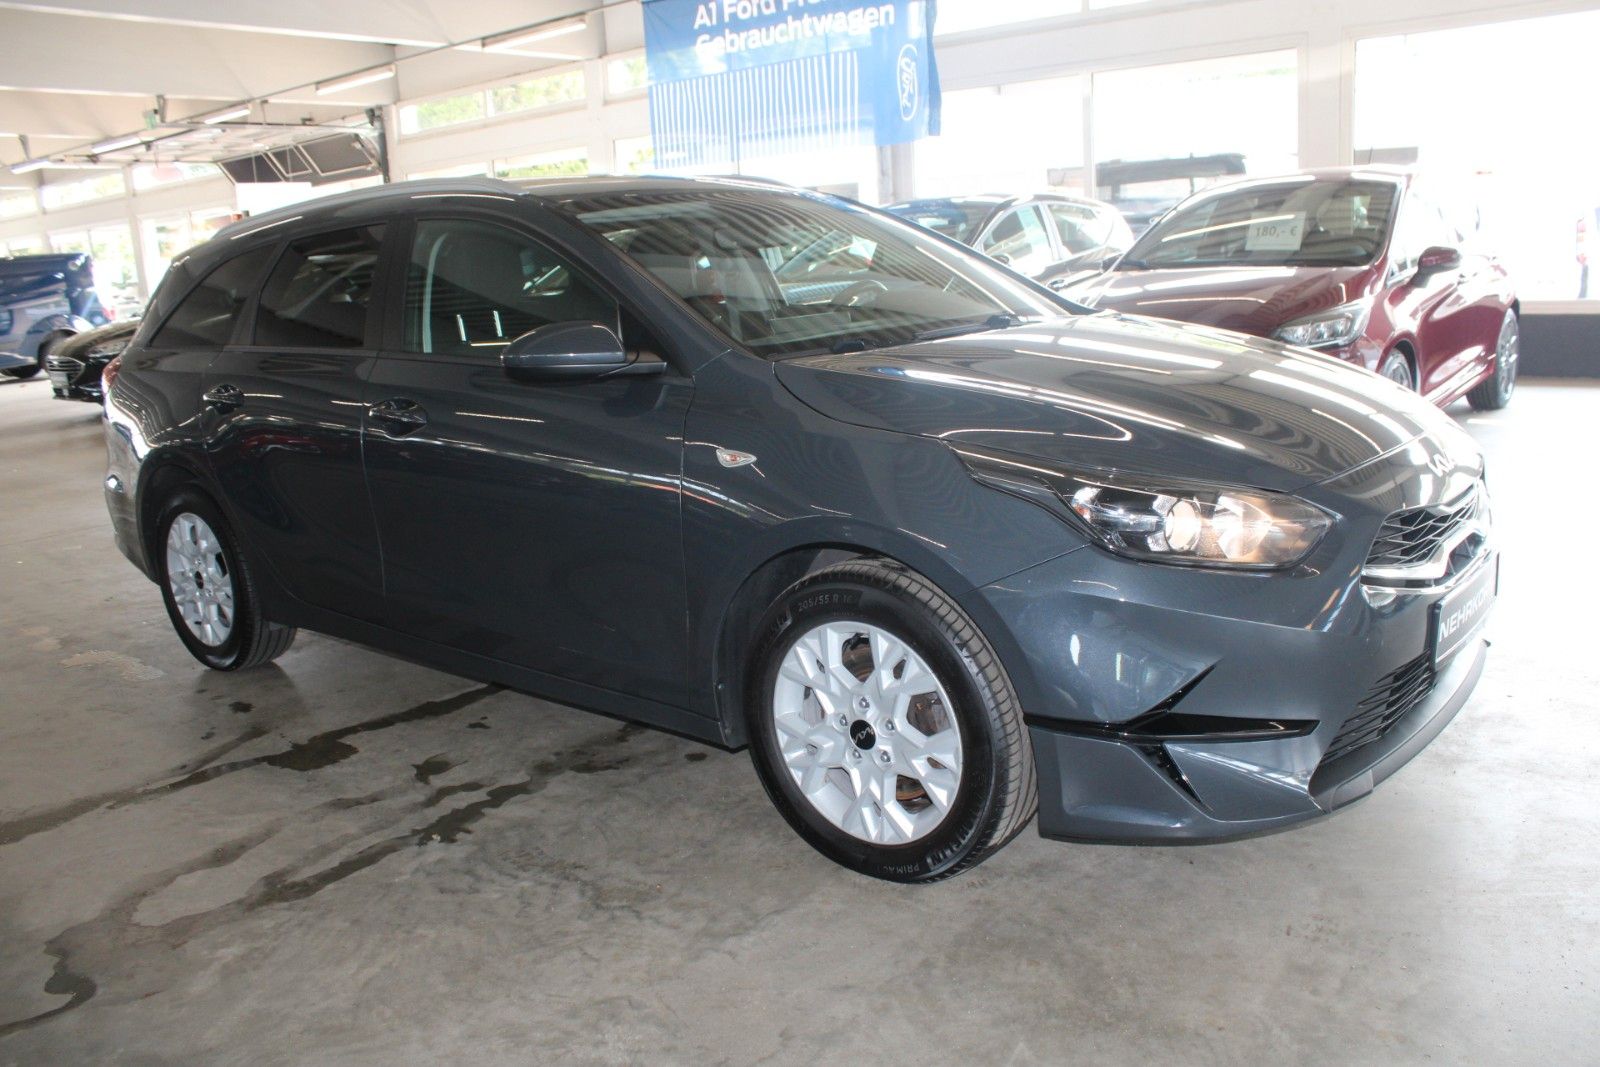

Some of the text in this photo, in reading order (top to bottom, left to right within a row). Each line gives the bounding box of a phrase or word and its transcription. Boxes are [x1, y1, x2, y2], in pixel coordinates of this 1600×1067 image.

[693, 1, 717, 29] A1
[723, 0, 776, 23] Ford
[694, 3, 895, 53] Gebrauchtwagen
